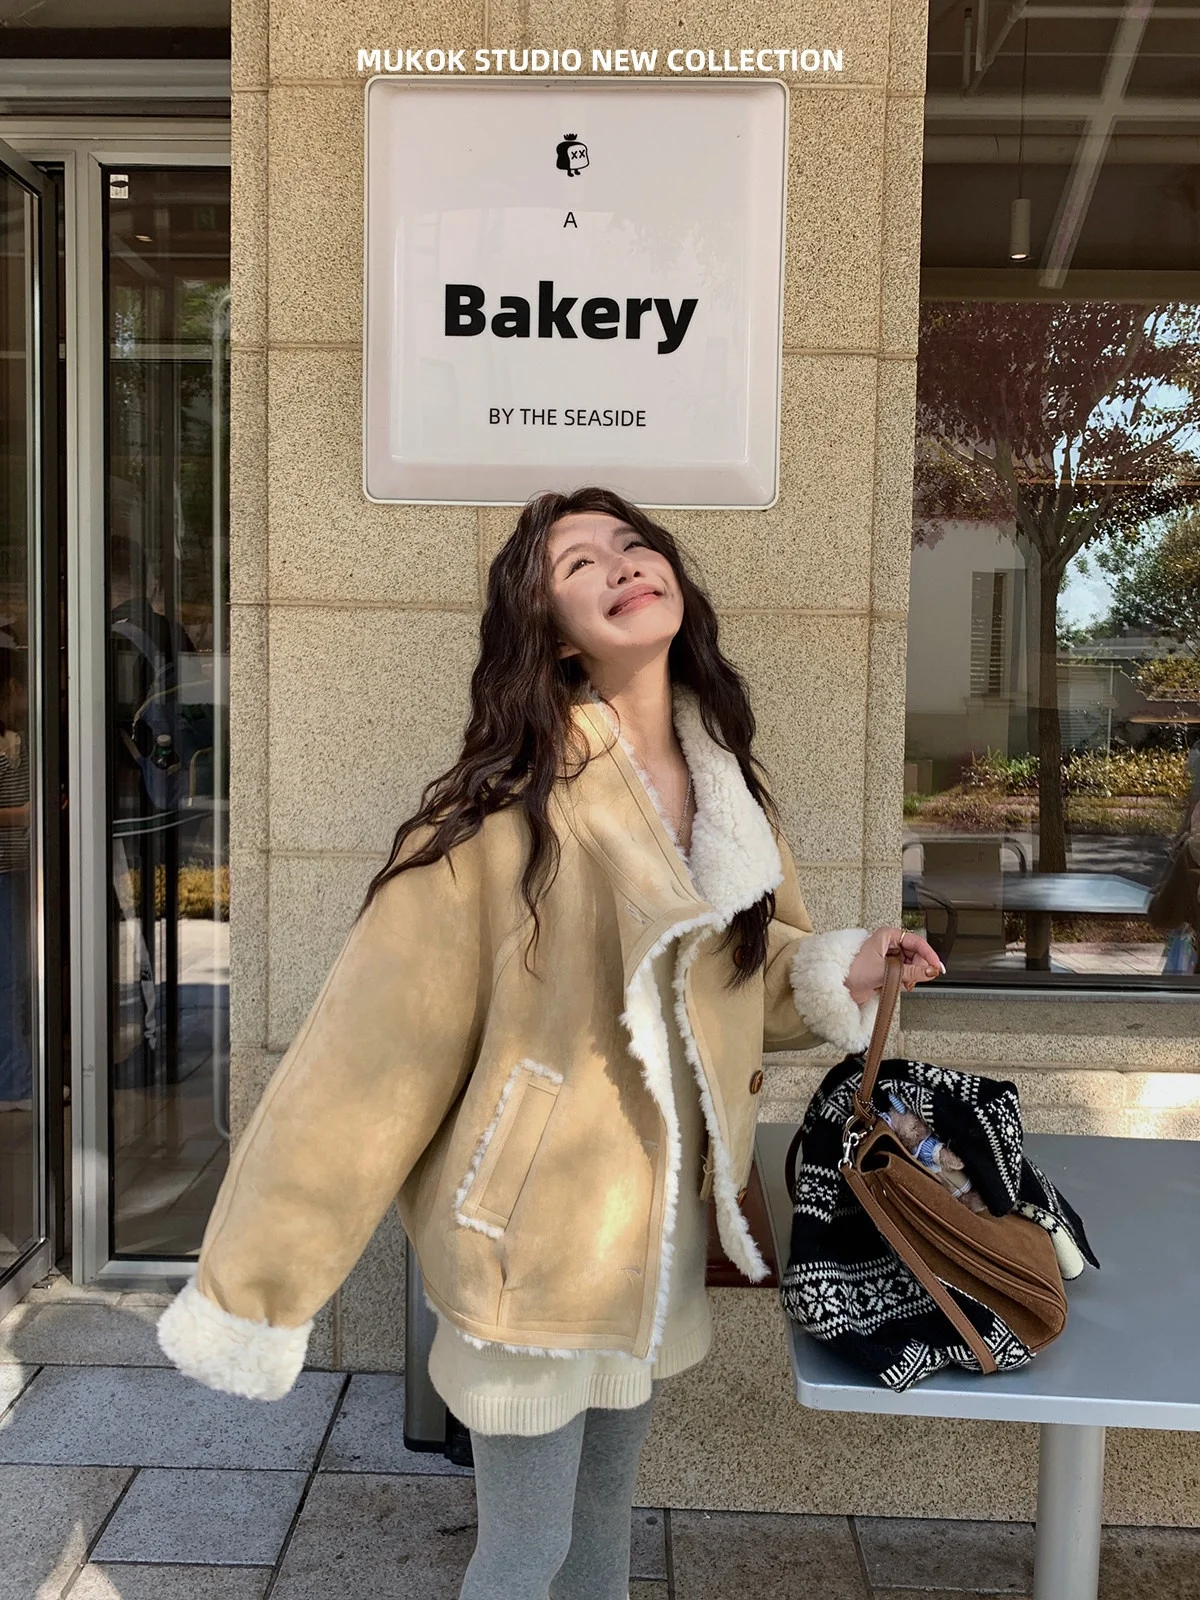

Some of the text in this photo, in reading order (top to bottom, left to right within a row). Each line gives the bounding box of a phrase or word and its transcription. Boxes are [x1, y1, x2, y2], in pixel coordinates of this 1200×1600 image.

[563, 211, 578, 229] A
[444, 280, 699, 355] Bakery
[488, 407, 647, 427] BY THE SEASIDE
